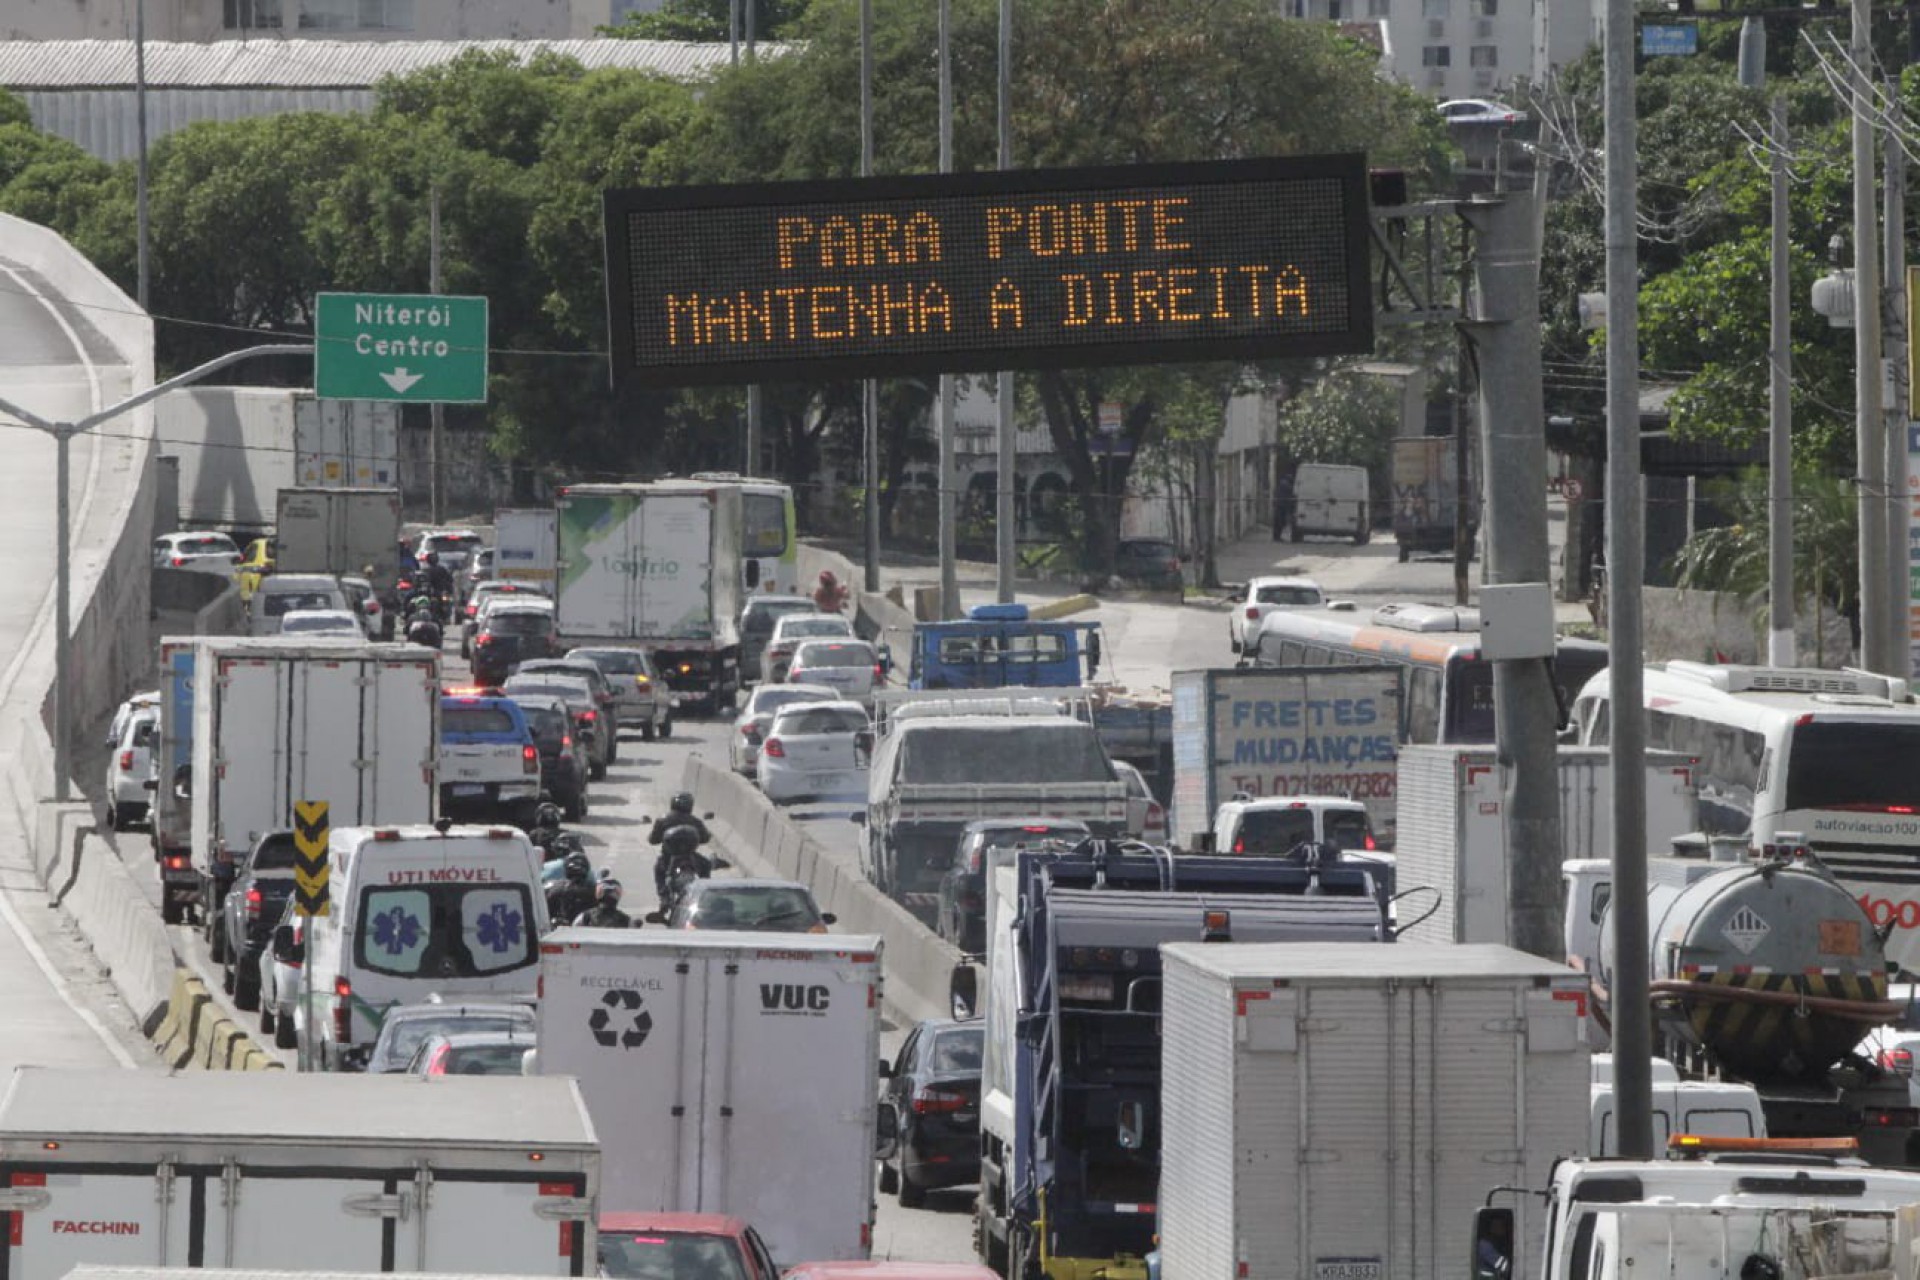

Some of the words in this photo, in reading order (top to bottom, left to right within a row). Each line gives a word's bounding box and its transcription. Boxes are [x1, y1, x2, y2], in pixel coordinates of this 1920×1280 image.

[777, 211, 942, 268] PARA
[987, 198, 1191, 258] PONTE
[355, 303, 450, 326] Niterói
[666, 281, 952, 345] MANTENHA
[991, 277, 1022, 329] A
[1059, 264, 1309, 327] DIREITA
[356, 333, 448, 357] Centro
[1232, 698, 1377, 727] FRETES
[1234, 735, 1396, 768] MUDANÇAS
[388, 869, 423, 885] UTI
[429, 864, 502, 882] MÓVEL
[580, 975, 664, 991] RECICLÁVEL
[760, 983, 830, 1010] VUC
[53, 1220, 140, 1236] FACCHINI
